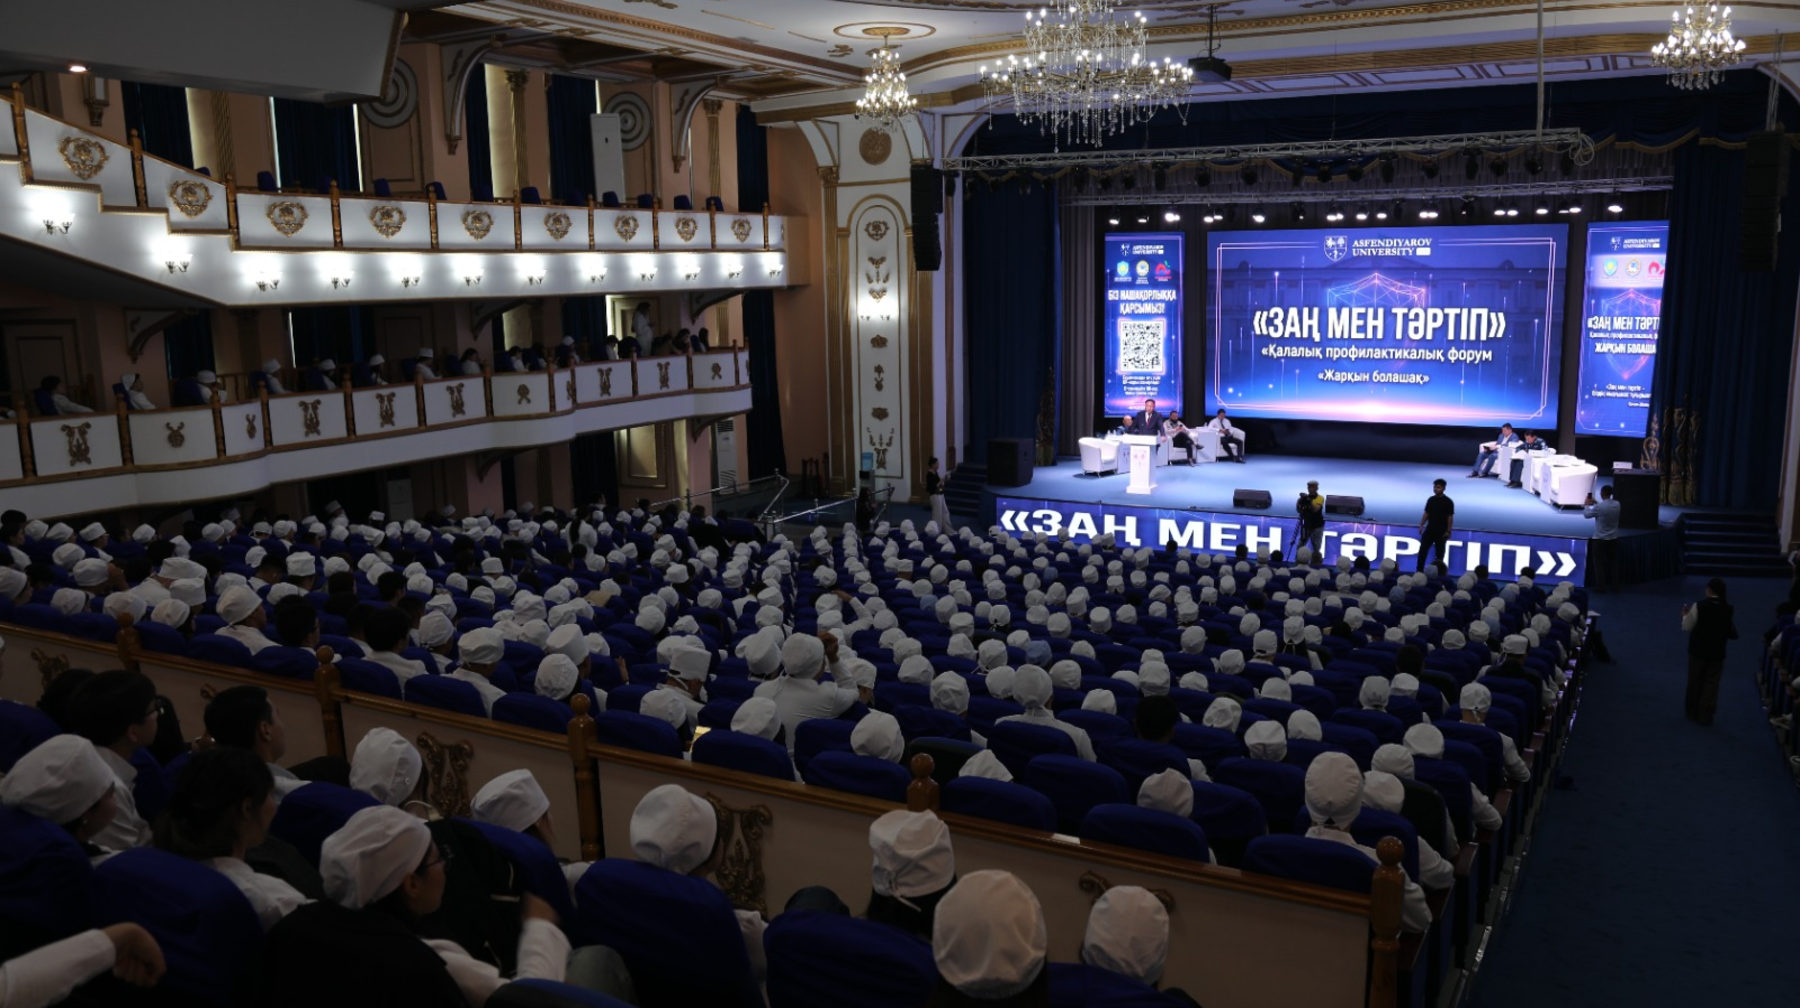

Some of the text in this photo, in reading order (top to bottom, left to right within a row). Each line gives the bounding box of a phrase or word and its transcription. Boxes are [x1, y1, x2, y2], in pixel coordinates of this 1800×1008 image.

[1352, 238, 1432, 247] ASFENDIYAROV
[1352, 247, 1414, 256] UNIVERSITY
[1120, 289, 1177, 301] НАШАҚОРЛЫҚҚА
[1253, 307, 1506, 342] «ЗАҢ МЕН ТӘРТІП»
[1613, 316, 1633, 330] МЕН
[1261, 344, 1493, 364] «Қалалық профилактикалық форум
[1595, 342, 1626, 354] ЖАРҚЫН
[1318, 369, 1430, 385] «Жарқын болашақ»
[1000, 509, 1141, 547] «ЗАҢ
[1159, 518, 1282, 553] МЕН
